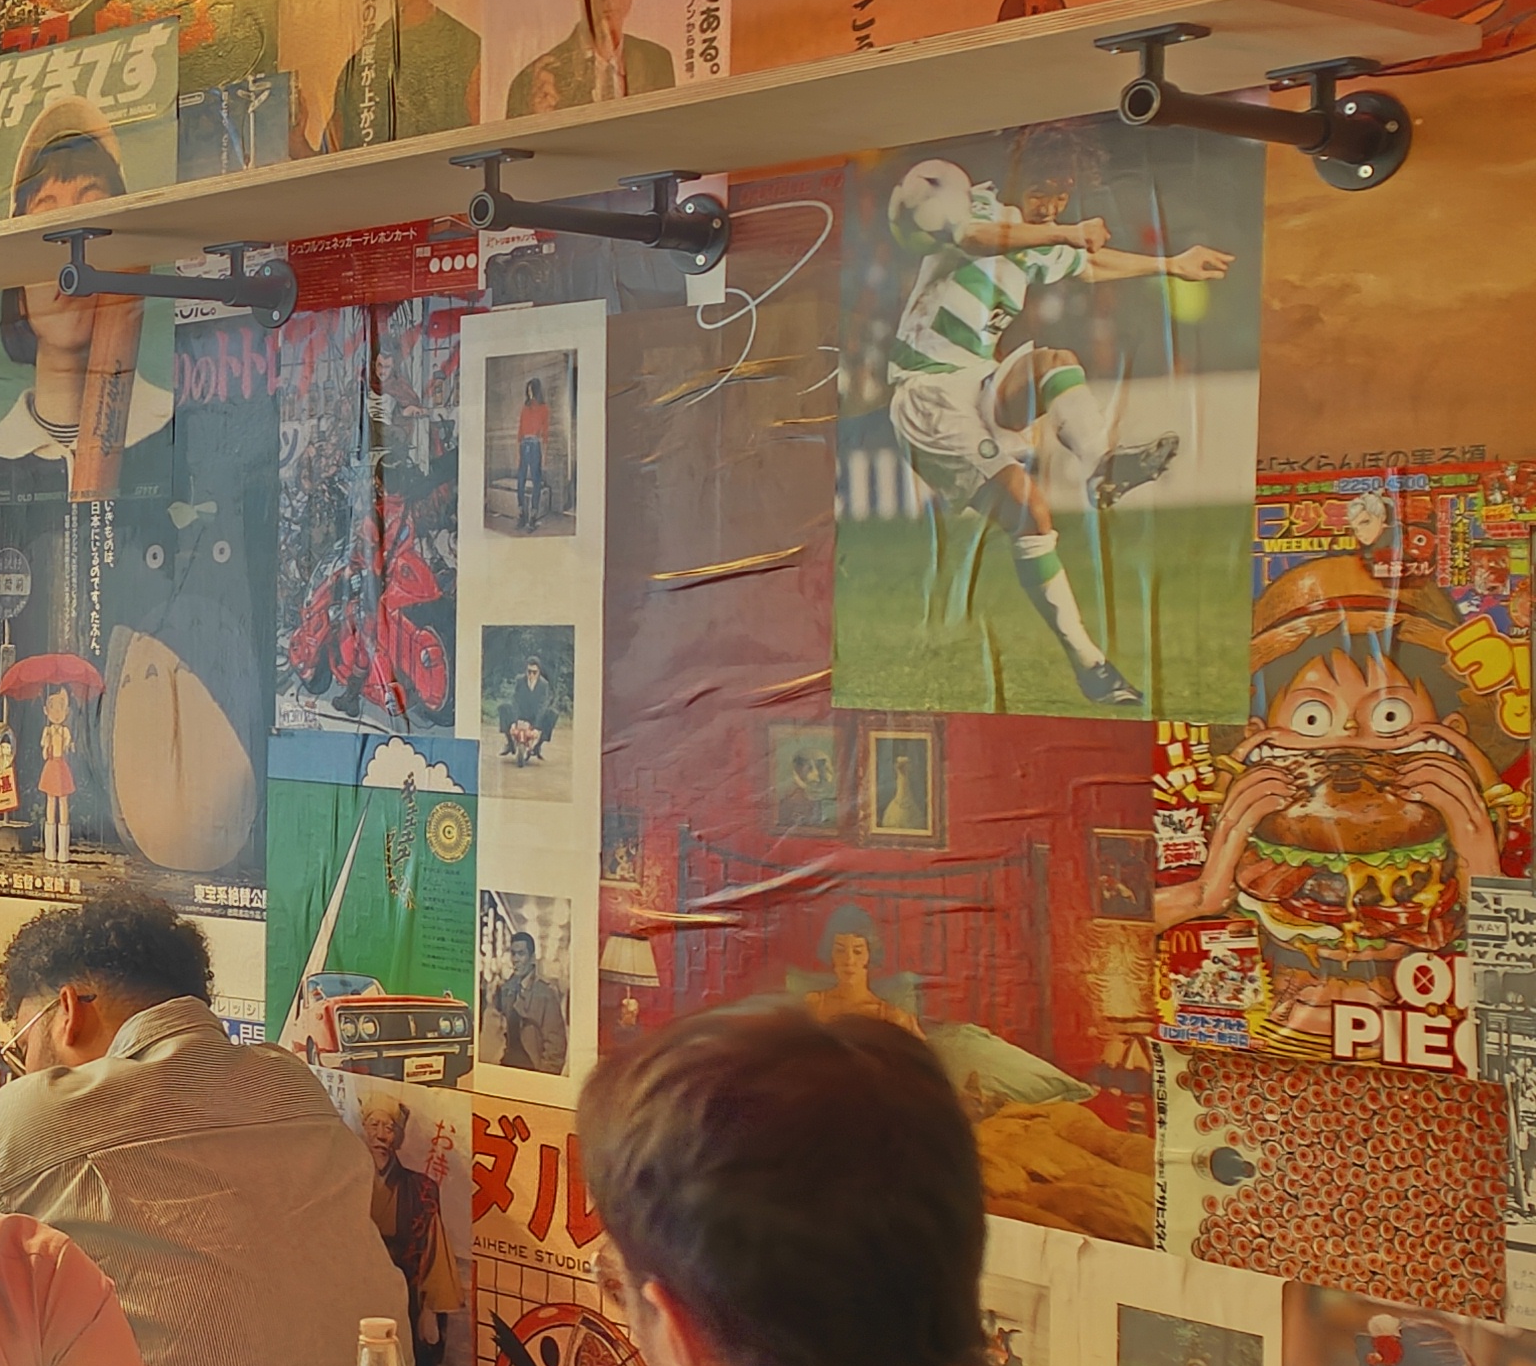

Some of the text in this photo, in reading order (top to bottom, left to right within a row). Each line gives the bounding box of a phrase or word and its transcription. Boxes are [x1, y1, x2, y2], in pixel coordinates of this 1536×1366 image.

[1263, 536, 1359, 553] WEEKLY JU
[1475, 922, 1503, 933] WAY
[472, 1236, 528, 1260] AIHEME
